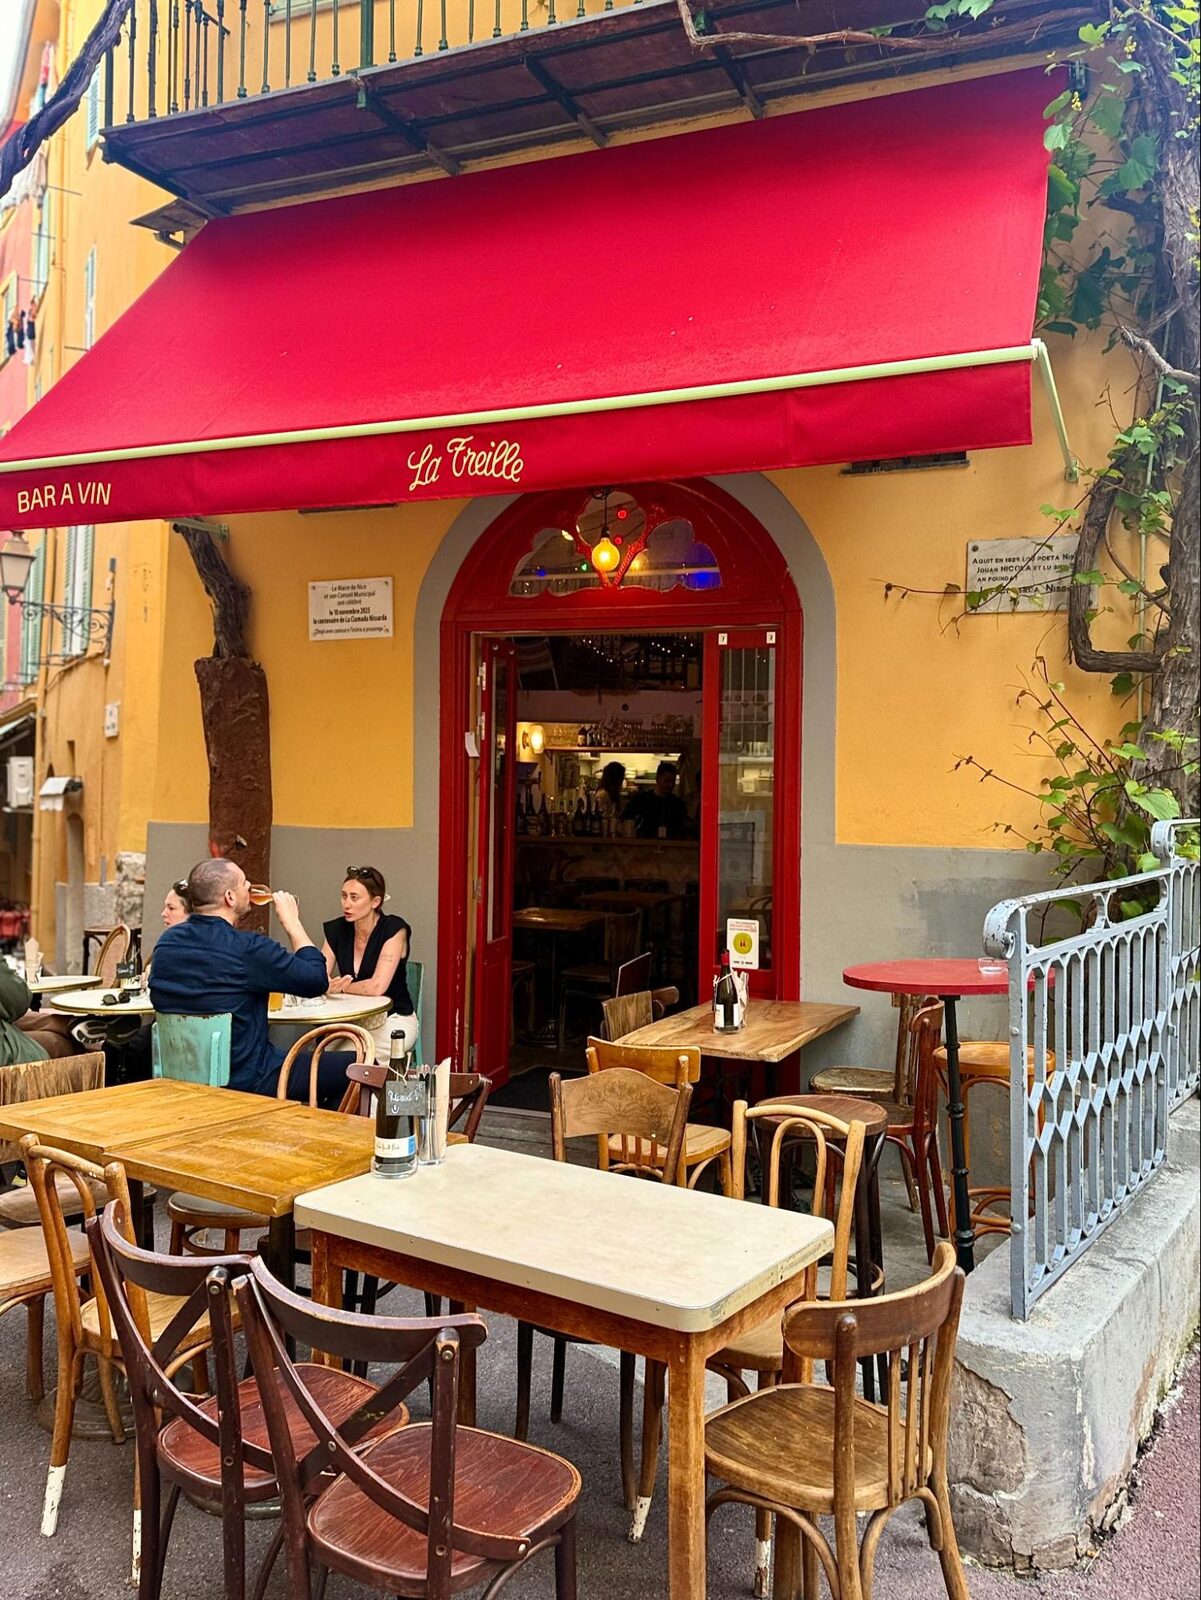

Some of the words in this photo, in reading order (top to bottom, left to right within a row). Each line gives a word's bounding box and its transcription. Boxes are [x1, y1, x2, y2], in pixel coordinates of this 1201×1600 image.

[407, 443, 442, 492] La
[446, 435, 524, 483] Treille
[17, 484, 57, 514] BAR
[59, 482, 75, 506] A
[77, 482, 112, 506] VIN
